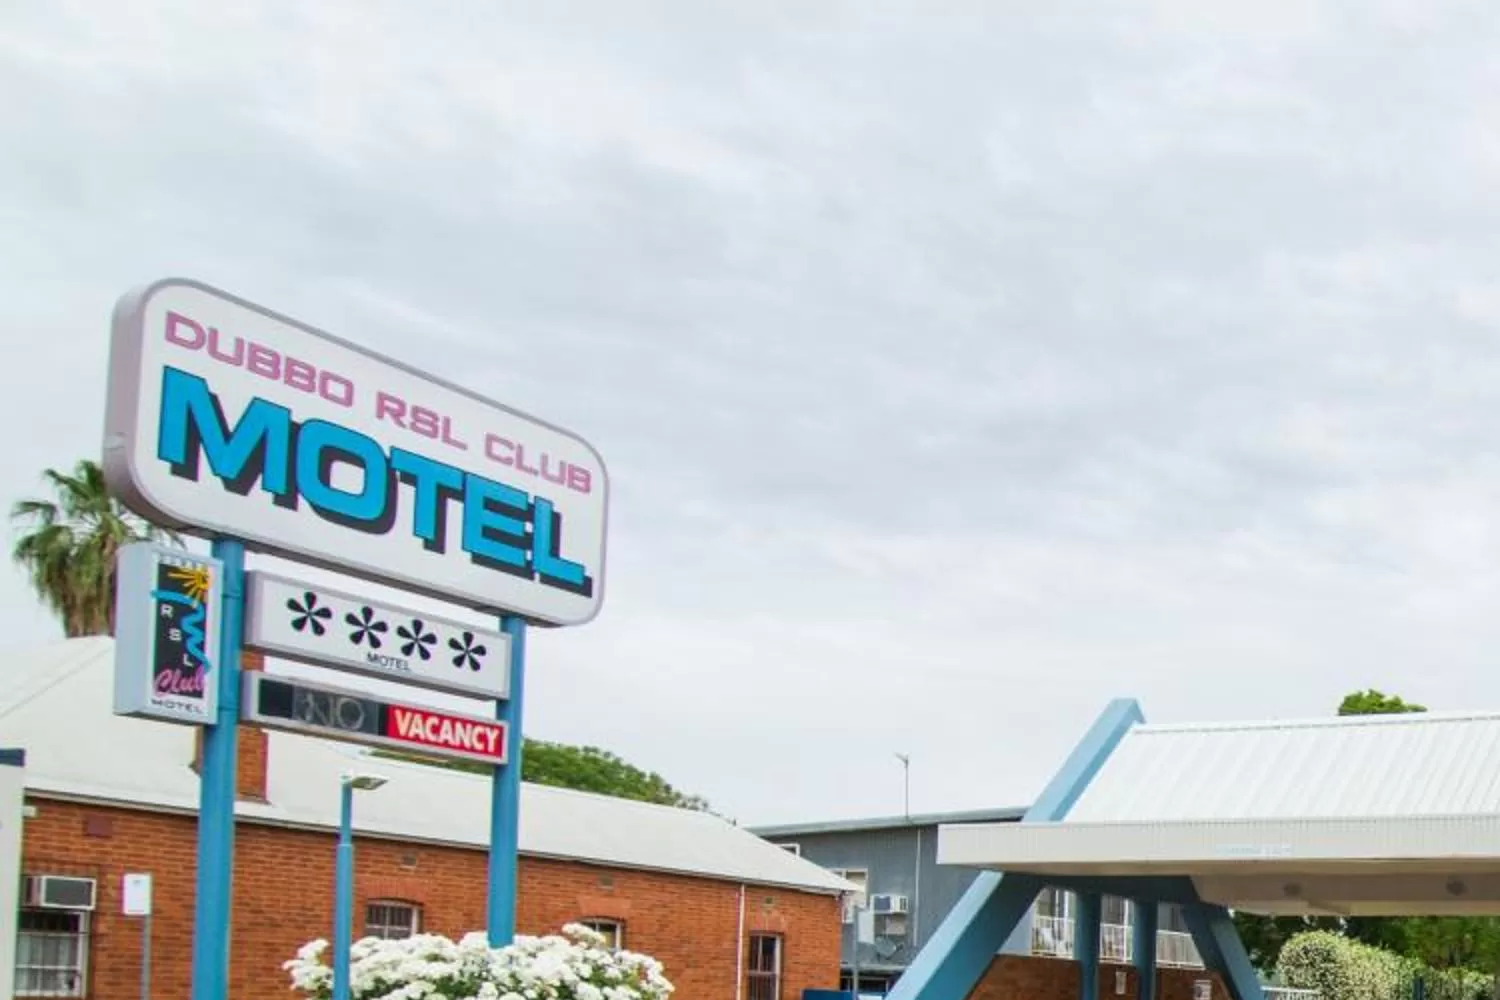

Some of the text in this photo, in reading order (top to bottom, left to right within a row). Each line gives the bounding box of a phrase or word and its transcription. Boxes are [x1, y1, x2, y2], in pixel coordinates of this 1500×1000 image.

[164, 311, 592, 494] DUBBO RSL CLUB
[158, 365, 593, 598] MOTEL
[156, 665, 207, 697] Club
[367, 652, 411, 671] MOTEL
[152, 698, 204, 714] MOTEL
[293, 690, 500, 750] NO VACANCY
